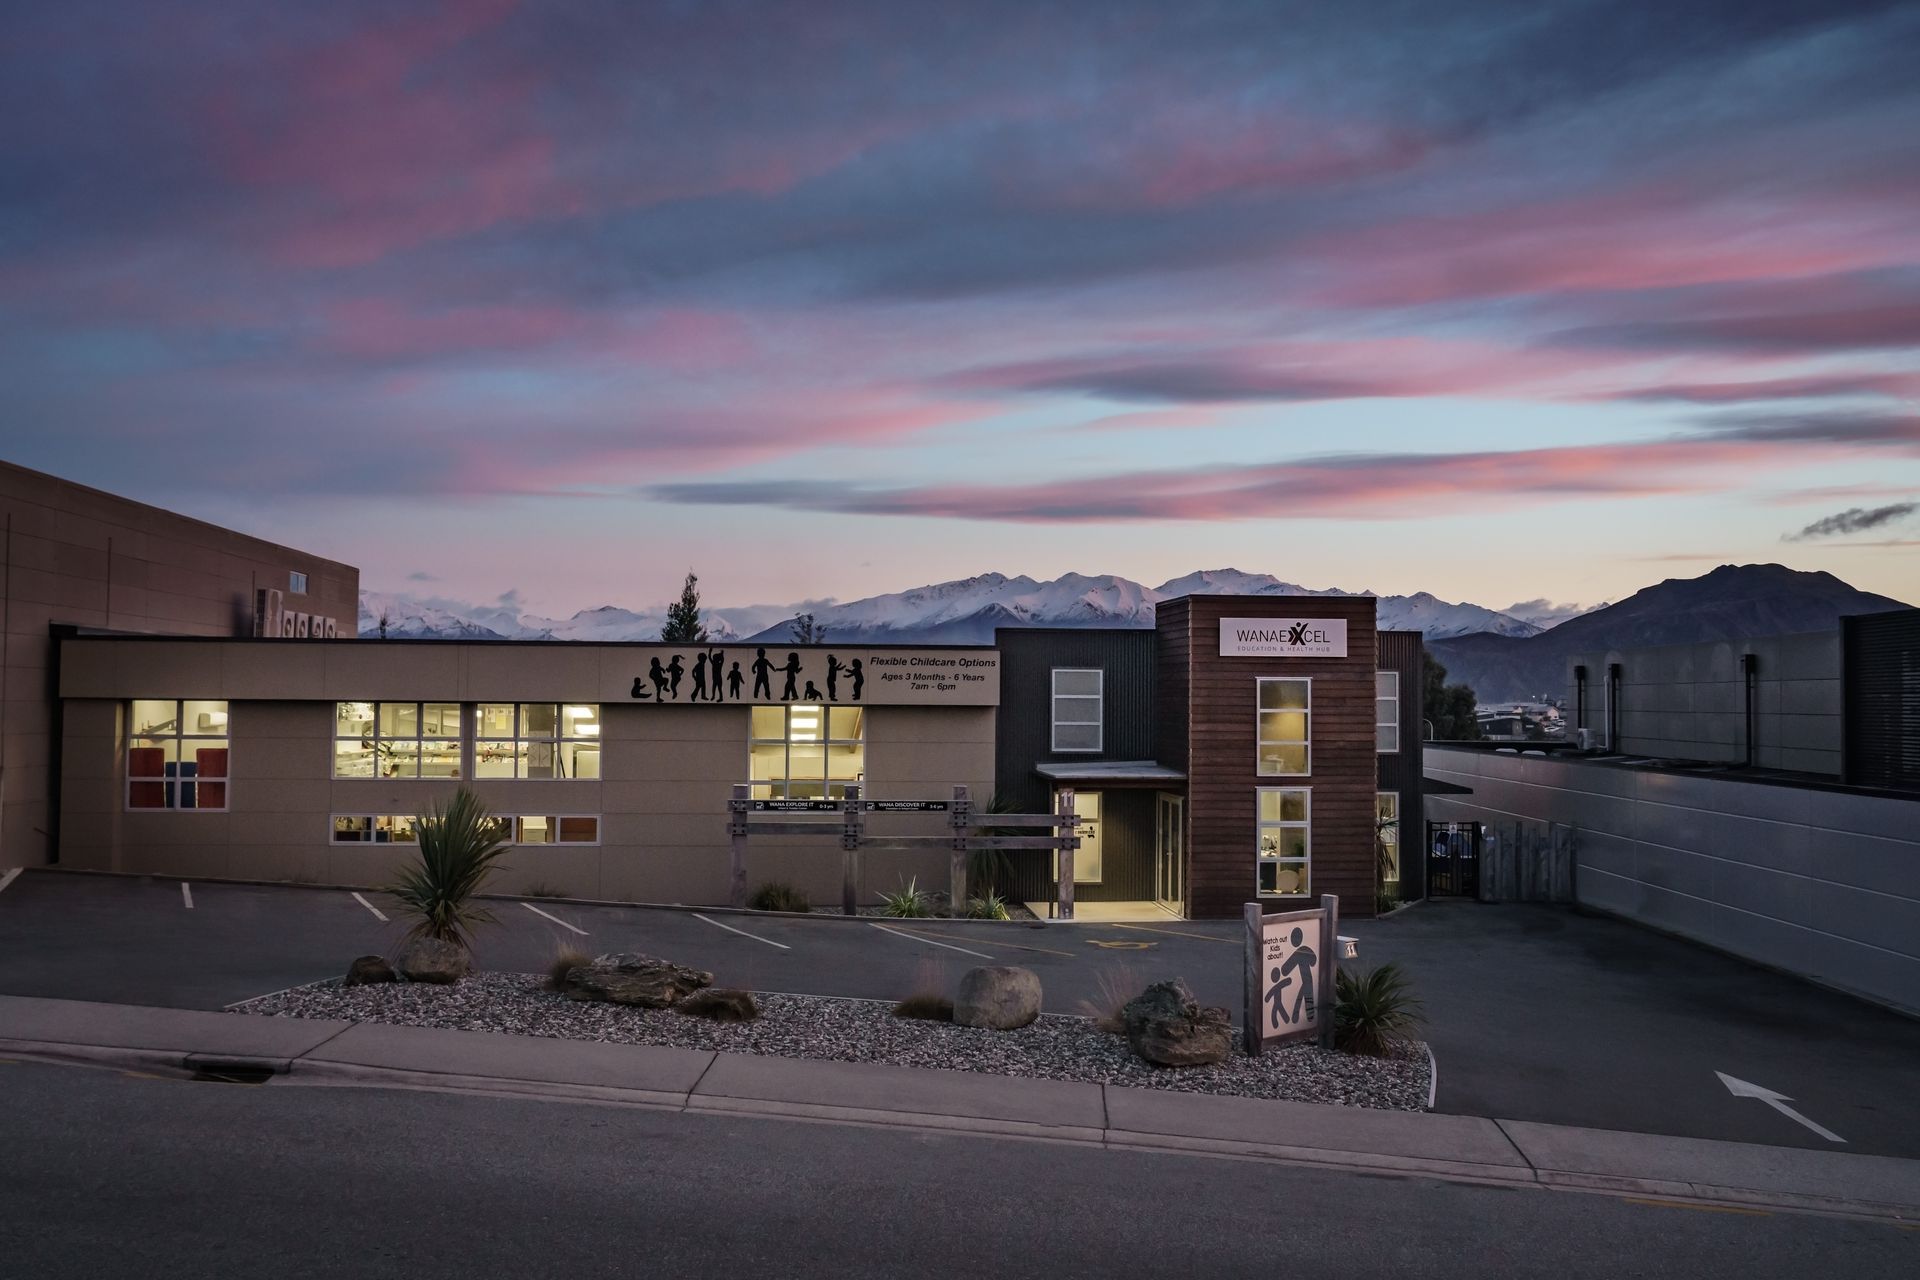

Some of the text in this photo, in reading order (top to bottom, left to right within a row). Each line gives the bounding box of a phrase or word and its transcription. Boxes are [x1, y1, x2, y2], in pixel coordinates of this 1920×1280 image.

[870, 657, 996, 668] Flexible Childcare Options
[881, 673, 903, 682] Ages
[913, 673, 946, 681] Months
[937, 683, 956, 691] 6pm
[1061, 791, 1074, 807] 11
[1270, 944, 1281, 952] Kids
[1346, 943, 1356, 956] 11
